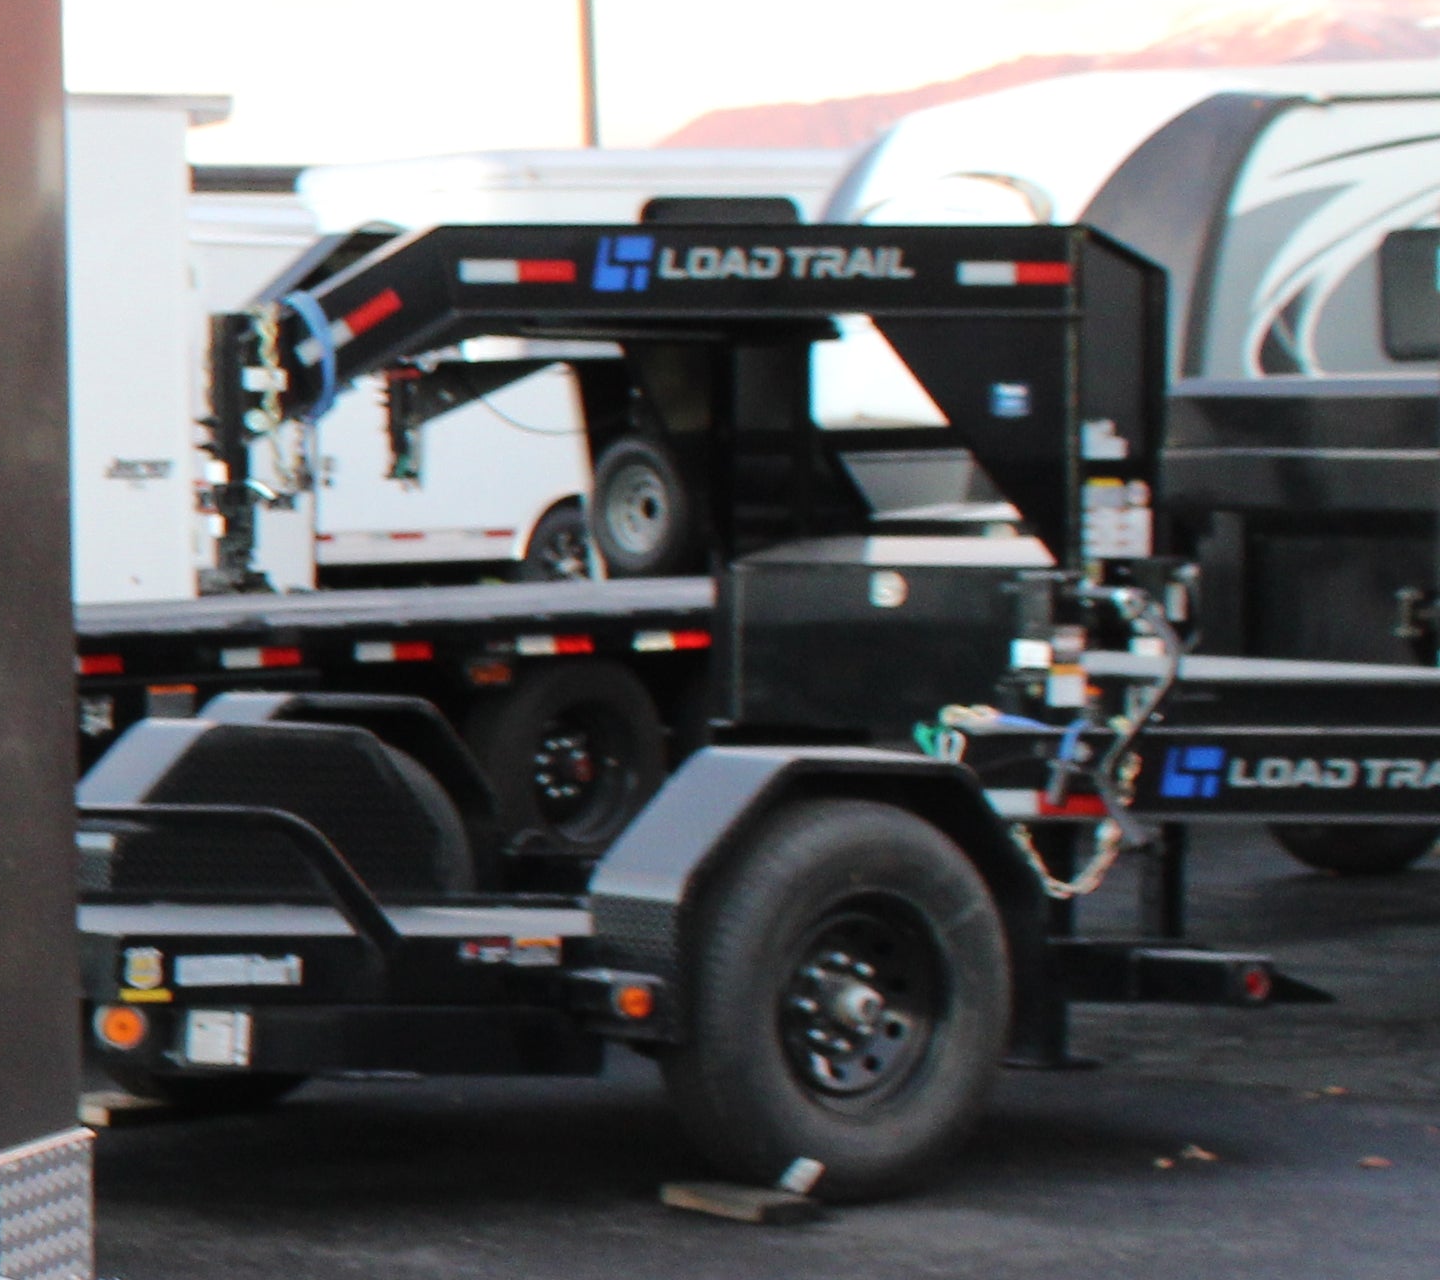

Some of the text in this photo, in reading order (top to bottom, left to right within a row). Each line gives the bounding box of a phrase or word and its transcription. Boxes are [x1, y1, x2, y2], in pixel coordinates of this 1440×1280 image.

[656, 245, 916, 281] LOAD TRAIL
[1227, 756, 1359, 790] LOAD
